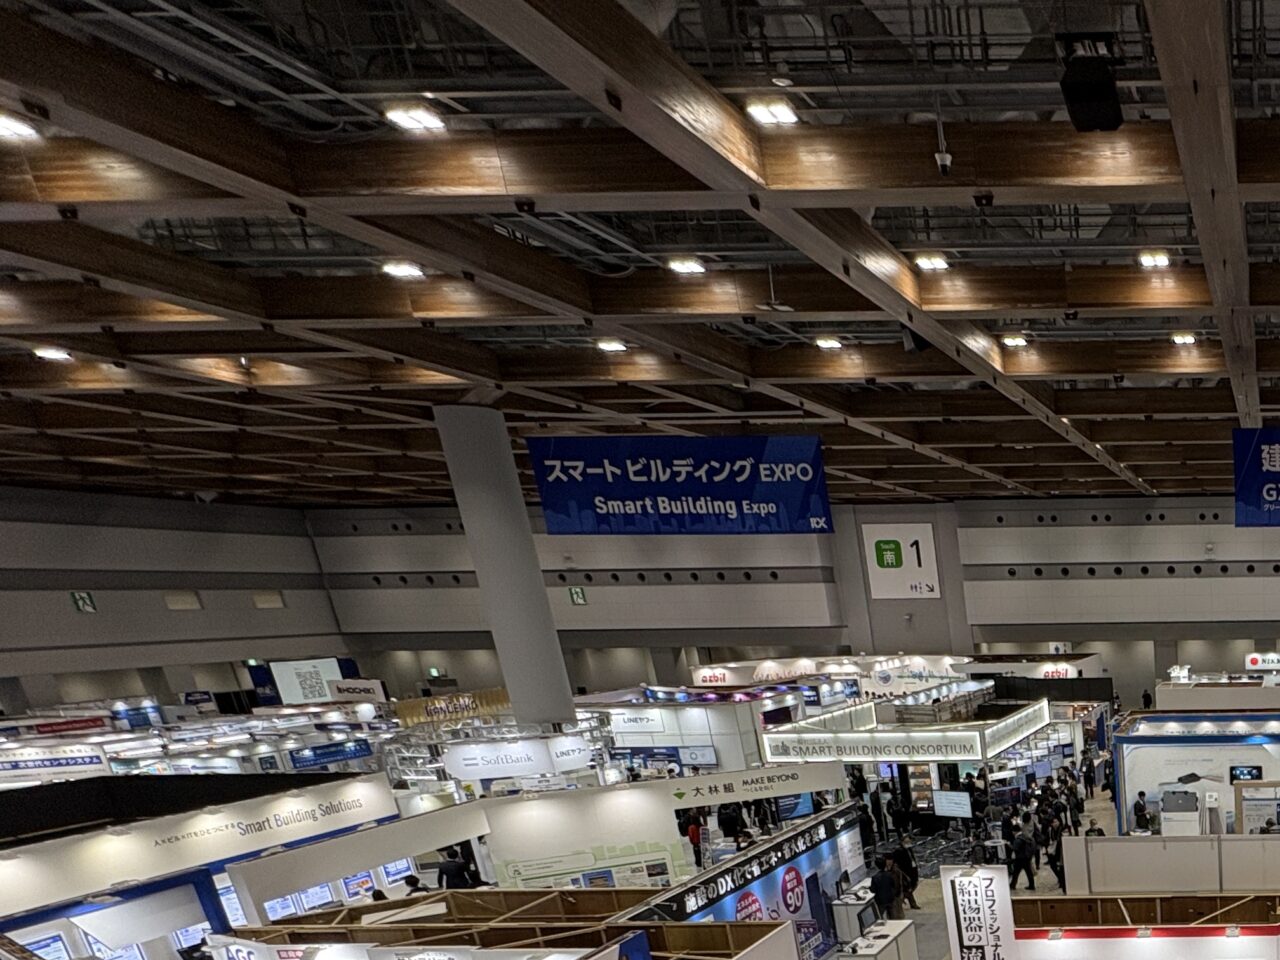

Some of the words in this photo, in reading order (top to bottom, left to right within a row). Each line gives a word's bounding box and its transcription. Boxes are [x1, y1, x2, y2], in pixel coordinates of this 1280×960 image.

[759, 462, 814, 482] EXPO
[594, 496, 654, 515] Smart
[658, 496, 737, 519] Building
[742, 500, 777, 516] Expo
[883, 551, 896, 567] 南
[909, 539, 923, 568] 1
[701, 672, 726, 684] azbil
[791, 744, 832, 756] SMART
[836, 744, 893, 756] BUILDING
[895, 743, 974, 756] CONSORTIUM
[481, 753, 534, 766] SoftBank
[742, 776, 766, 787] MAKE
[767, 773, 799, 784] BEYOND
[236, 817, 273, 836] Smart
[274, 808, 319, 828] Building
[319, 799, 363, 817] Solutions
